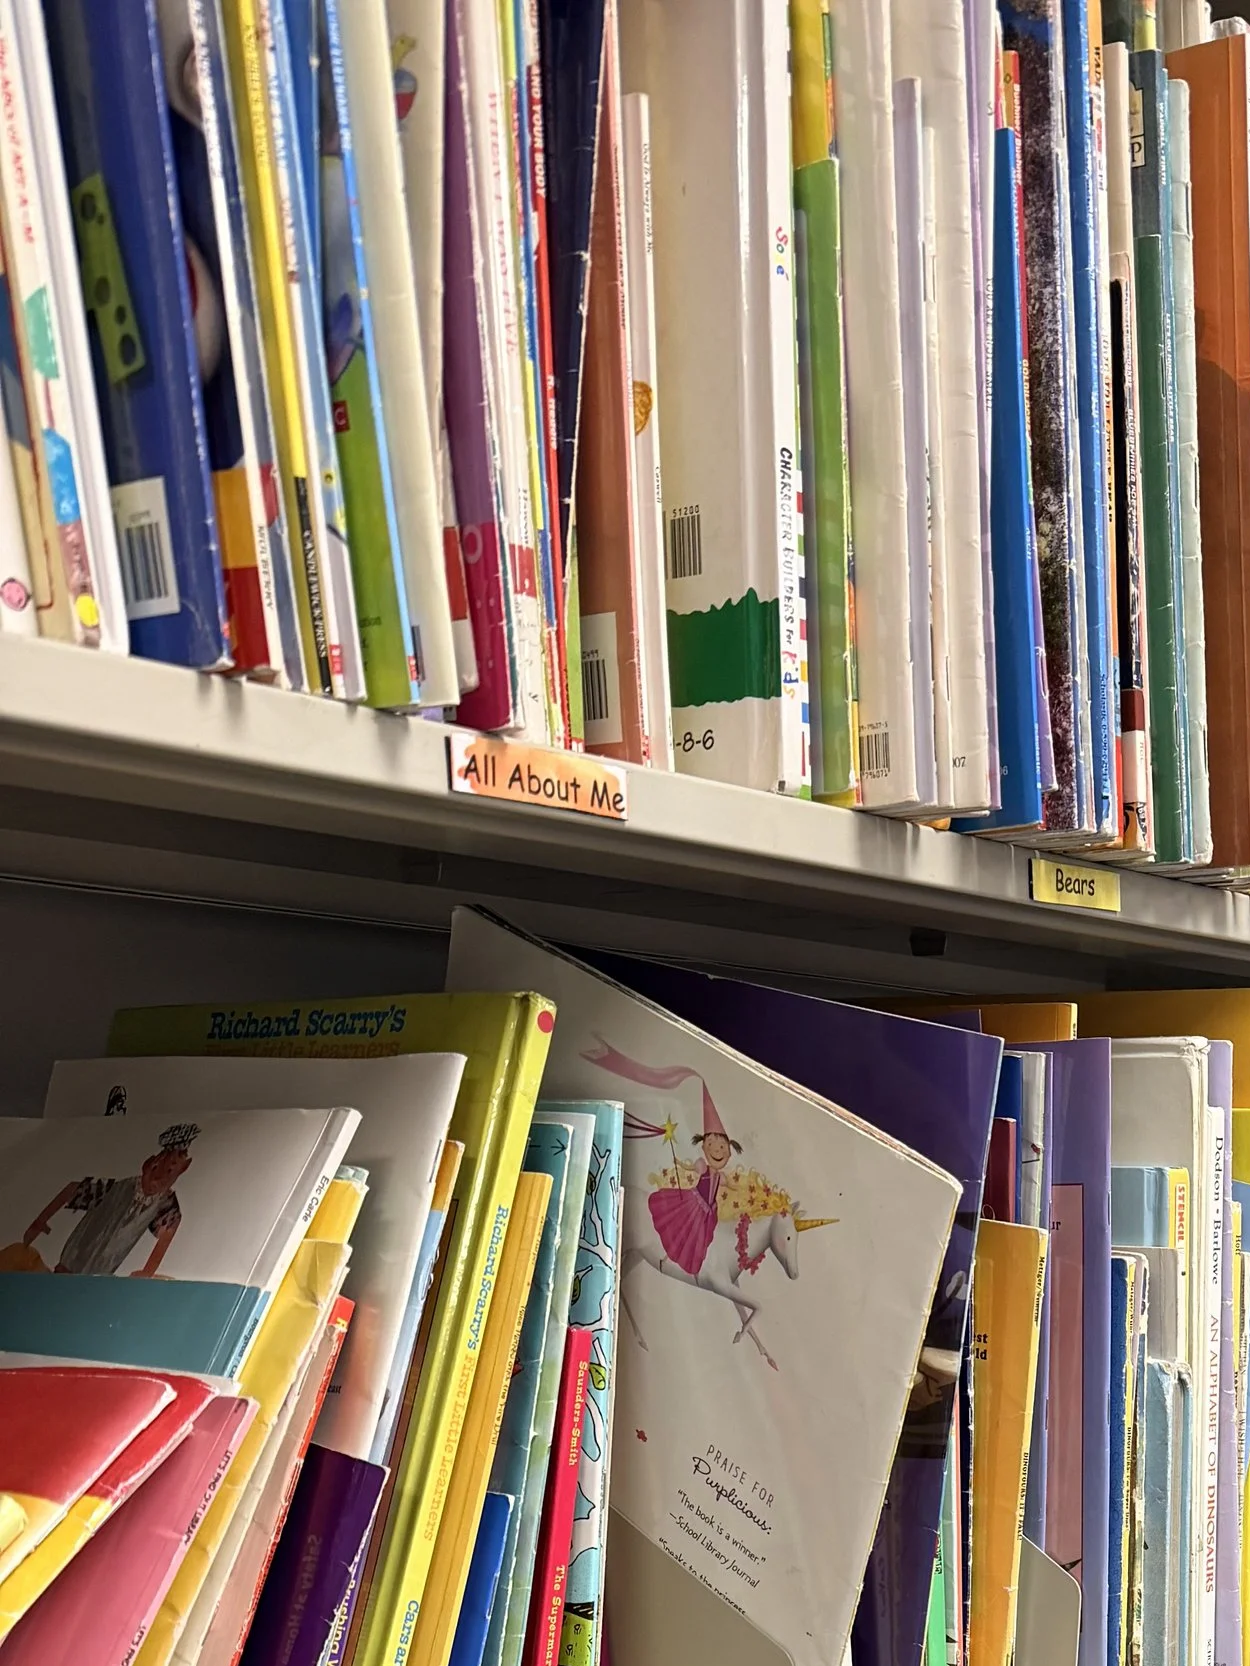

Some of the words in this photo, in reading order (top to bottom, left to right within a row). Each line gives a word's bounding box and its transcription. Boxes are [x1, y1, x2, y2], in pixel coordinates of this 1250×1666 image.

[528, 65, 542, 98] AND
[530, 103, 544, 147] YOUR
[532, 151, 547, 197] BODY
[779, 448, 793, 541] CHARACTER
[302, 530, 321, 616] CANDLEWICK
[313, 617, 326, 658] PRESS
[782, 547, 795, 624] BUILDERS
[464, 755, 496, 789] All
[507, 765, 580, 800] About
[591, 779, 626, 813] Me
[1055, 868, 1095, 897] Bears
[207, 1009, 300, 1040] Richard
[305, 1004, 407, 1037] Scarry's
[314, 1174, 329, 1196] Eric
[1213, 1136, 1223, 1201] Dodson
[301, 1195, 319, 1223] Carle
[1177, 1185, 1185, 1242] STENCIL
[477, 1204, 511, 1285] Richard
[1211, 1220, 1221, 1284] Barlowe
[465, 1278, 495, 1352] Scarry's
[1209, 1315, 1219, 1342] AN
[453, 1351, 477, 1400] First
[1207, 1350, 1218, 1444] ALPHABET
[443, 1400, 464, 1453] Little
[567, 1358, 589, 1467] Saunders-Smith
[706, 1444, 746, 1485] PRAISE
[751, 1481, 775, 1508] FOR
[1207, 1452, 1216, 1476] OF
[423, 1451, 453, 1543] Learners
[692, 1456, 772, 1535] Purplicious:
[696, 1505, 715, 1528] book
[716, 1522, 724, 1535] is
[701, 1535, 729, 1565] Library
[726, 1560, 761, 1588] Journal
[1204, 1485, 1216, 1593] DINOSAURS
[552, 1564, 567, 1593] The
[404, 1599, 422, 1640] Cars
